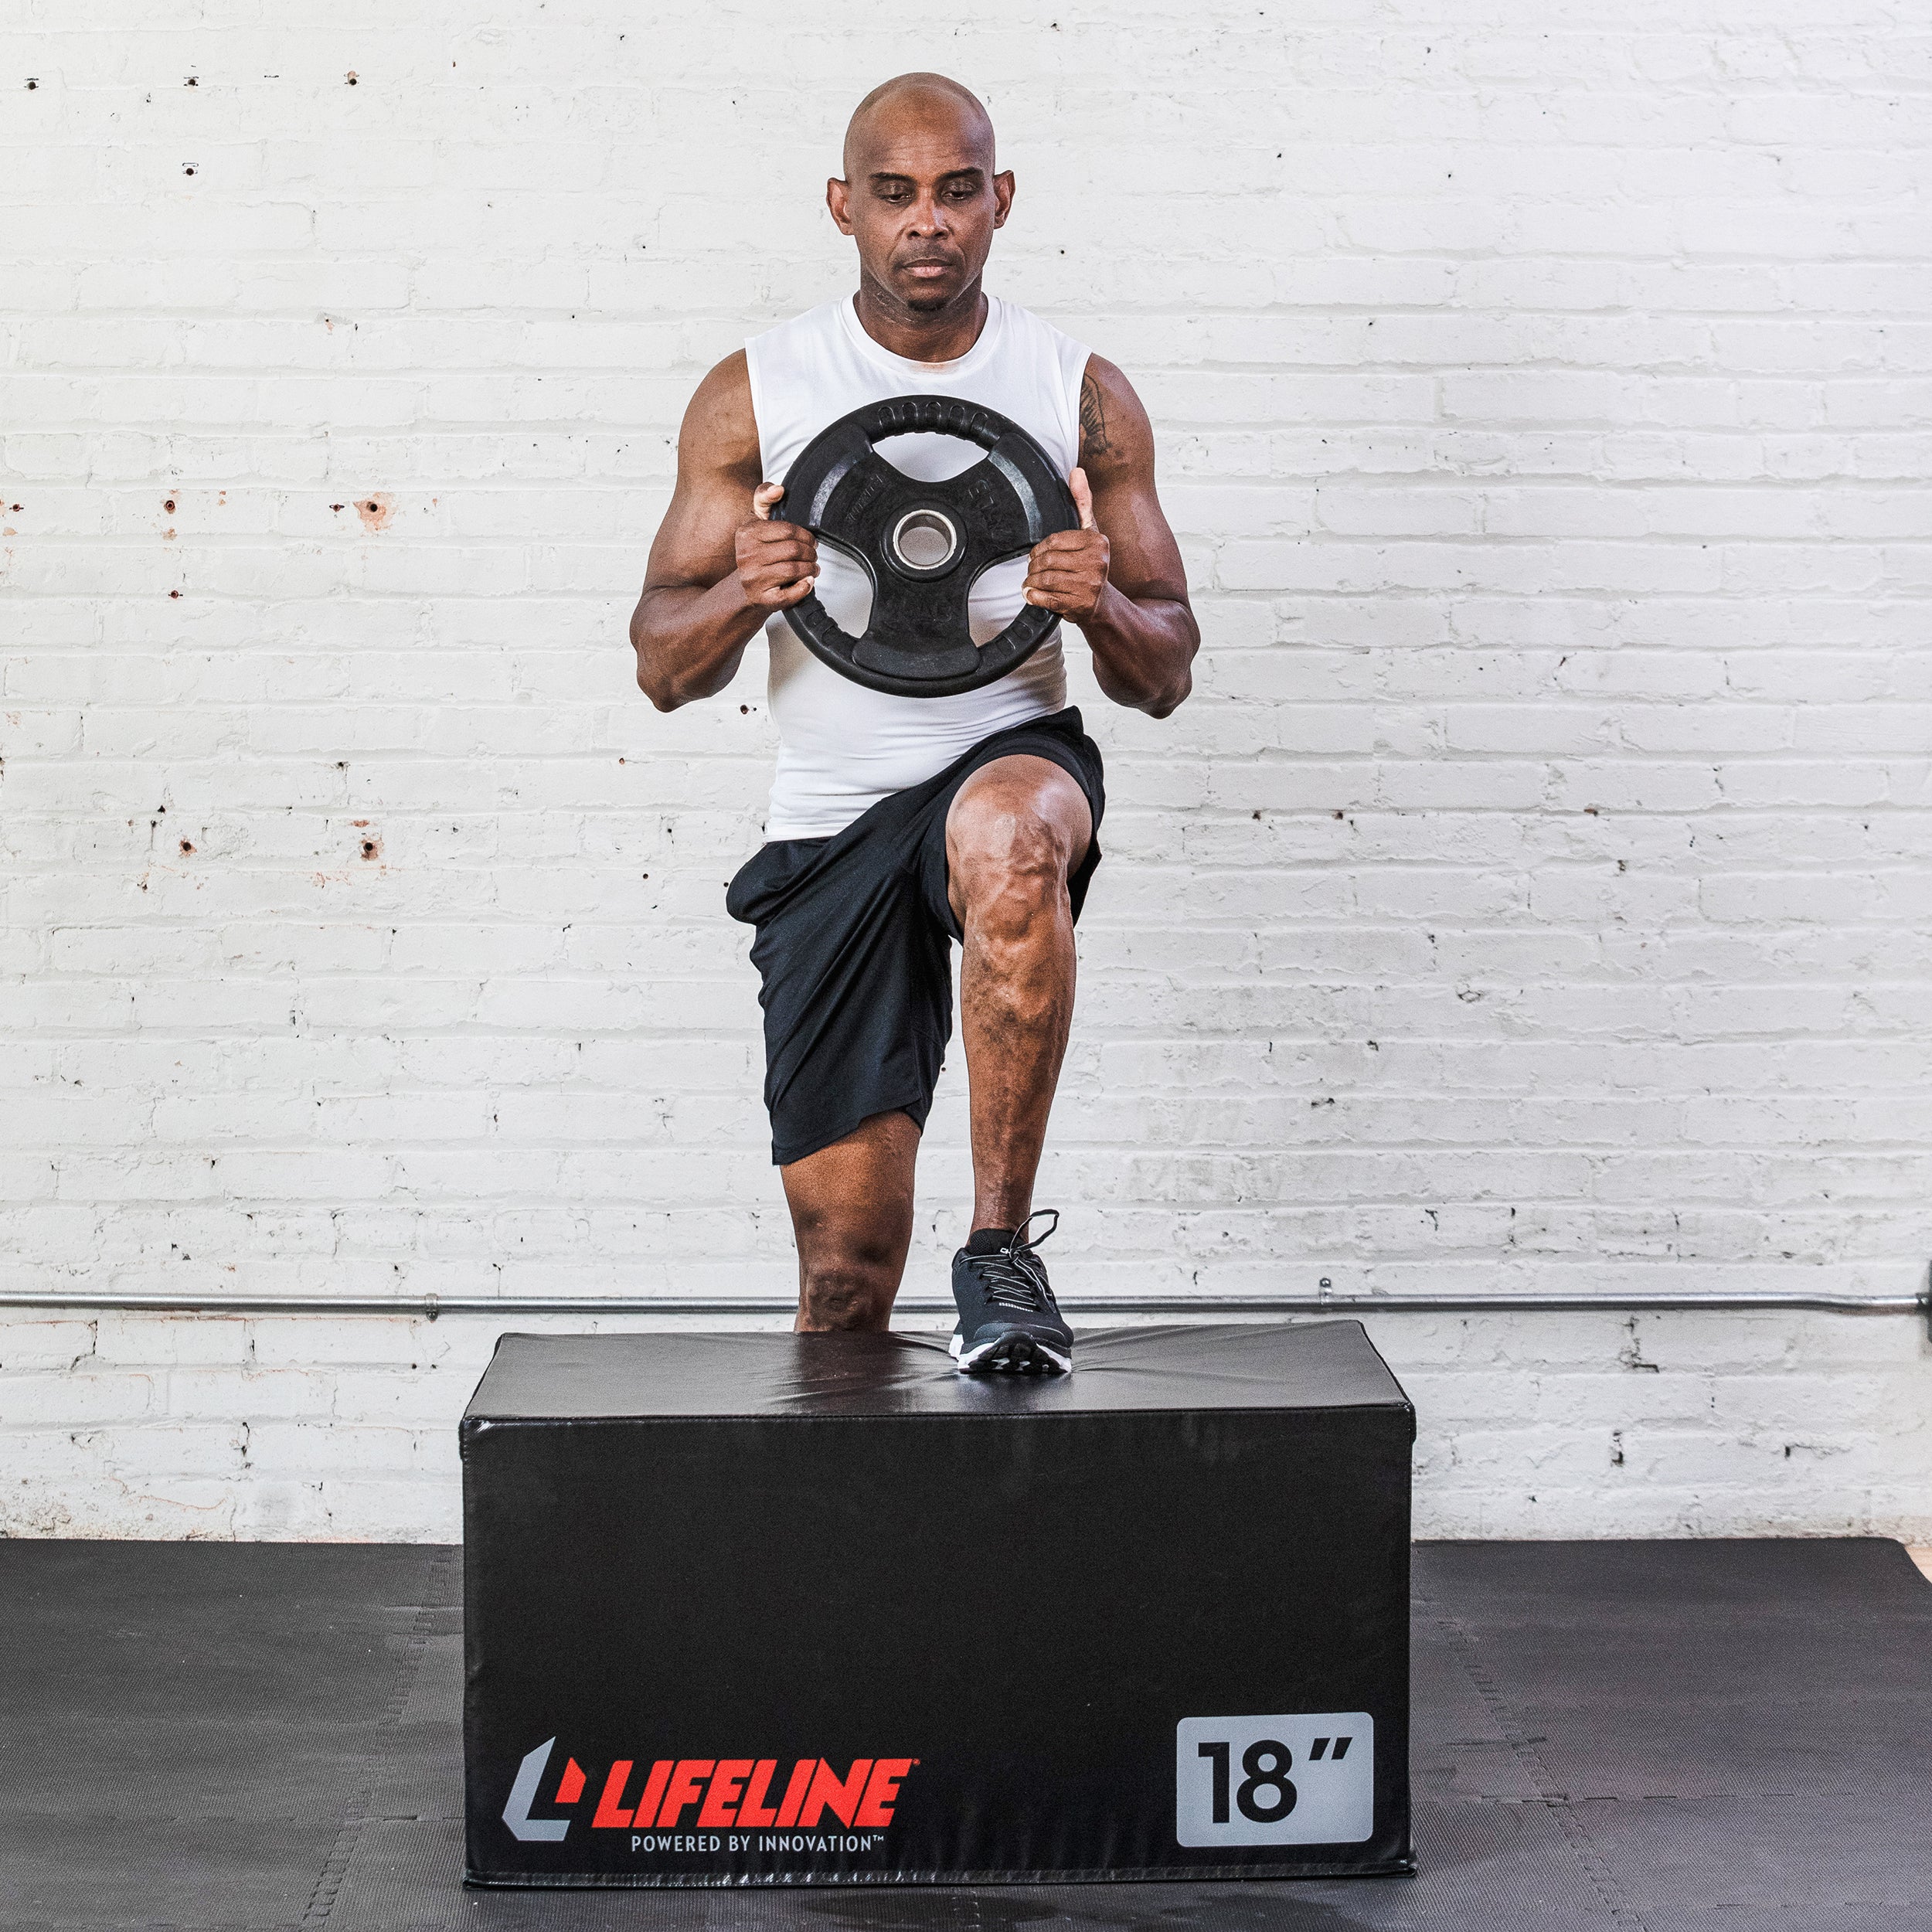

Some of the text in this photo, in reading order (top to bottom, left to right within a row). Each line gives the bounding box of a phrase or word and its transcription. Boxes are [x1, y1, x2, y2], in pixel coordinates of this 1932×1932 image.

[591, 1757, 913, 1828] LIFELINE
[631, 1835, 721, 1852] POWERED
[729, 1835, 750, 1852] BY
